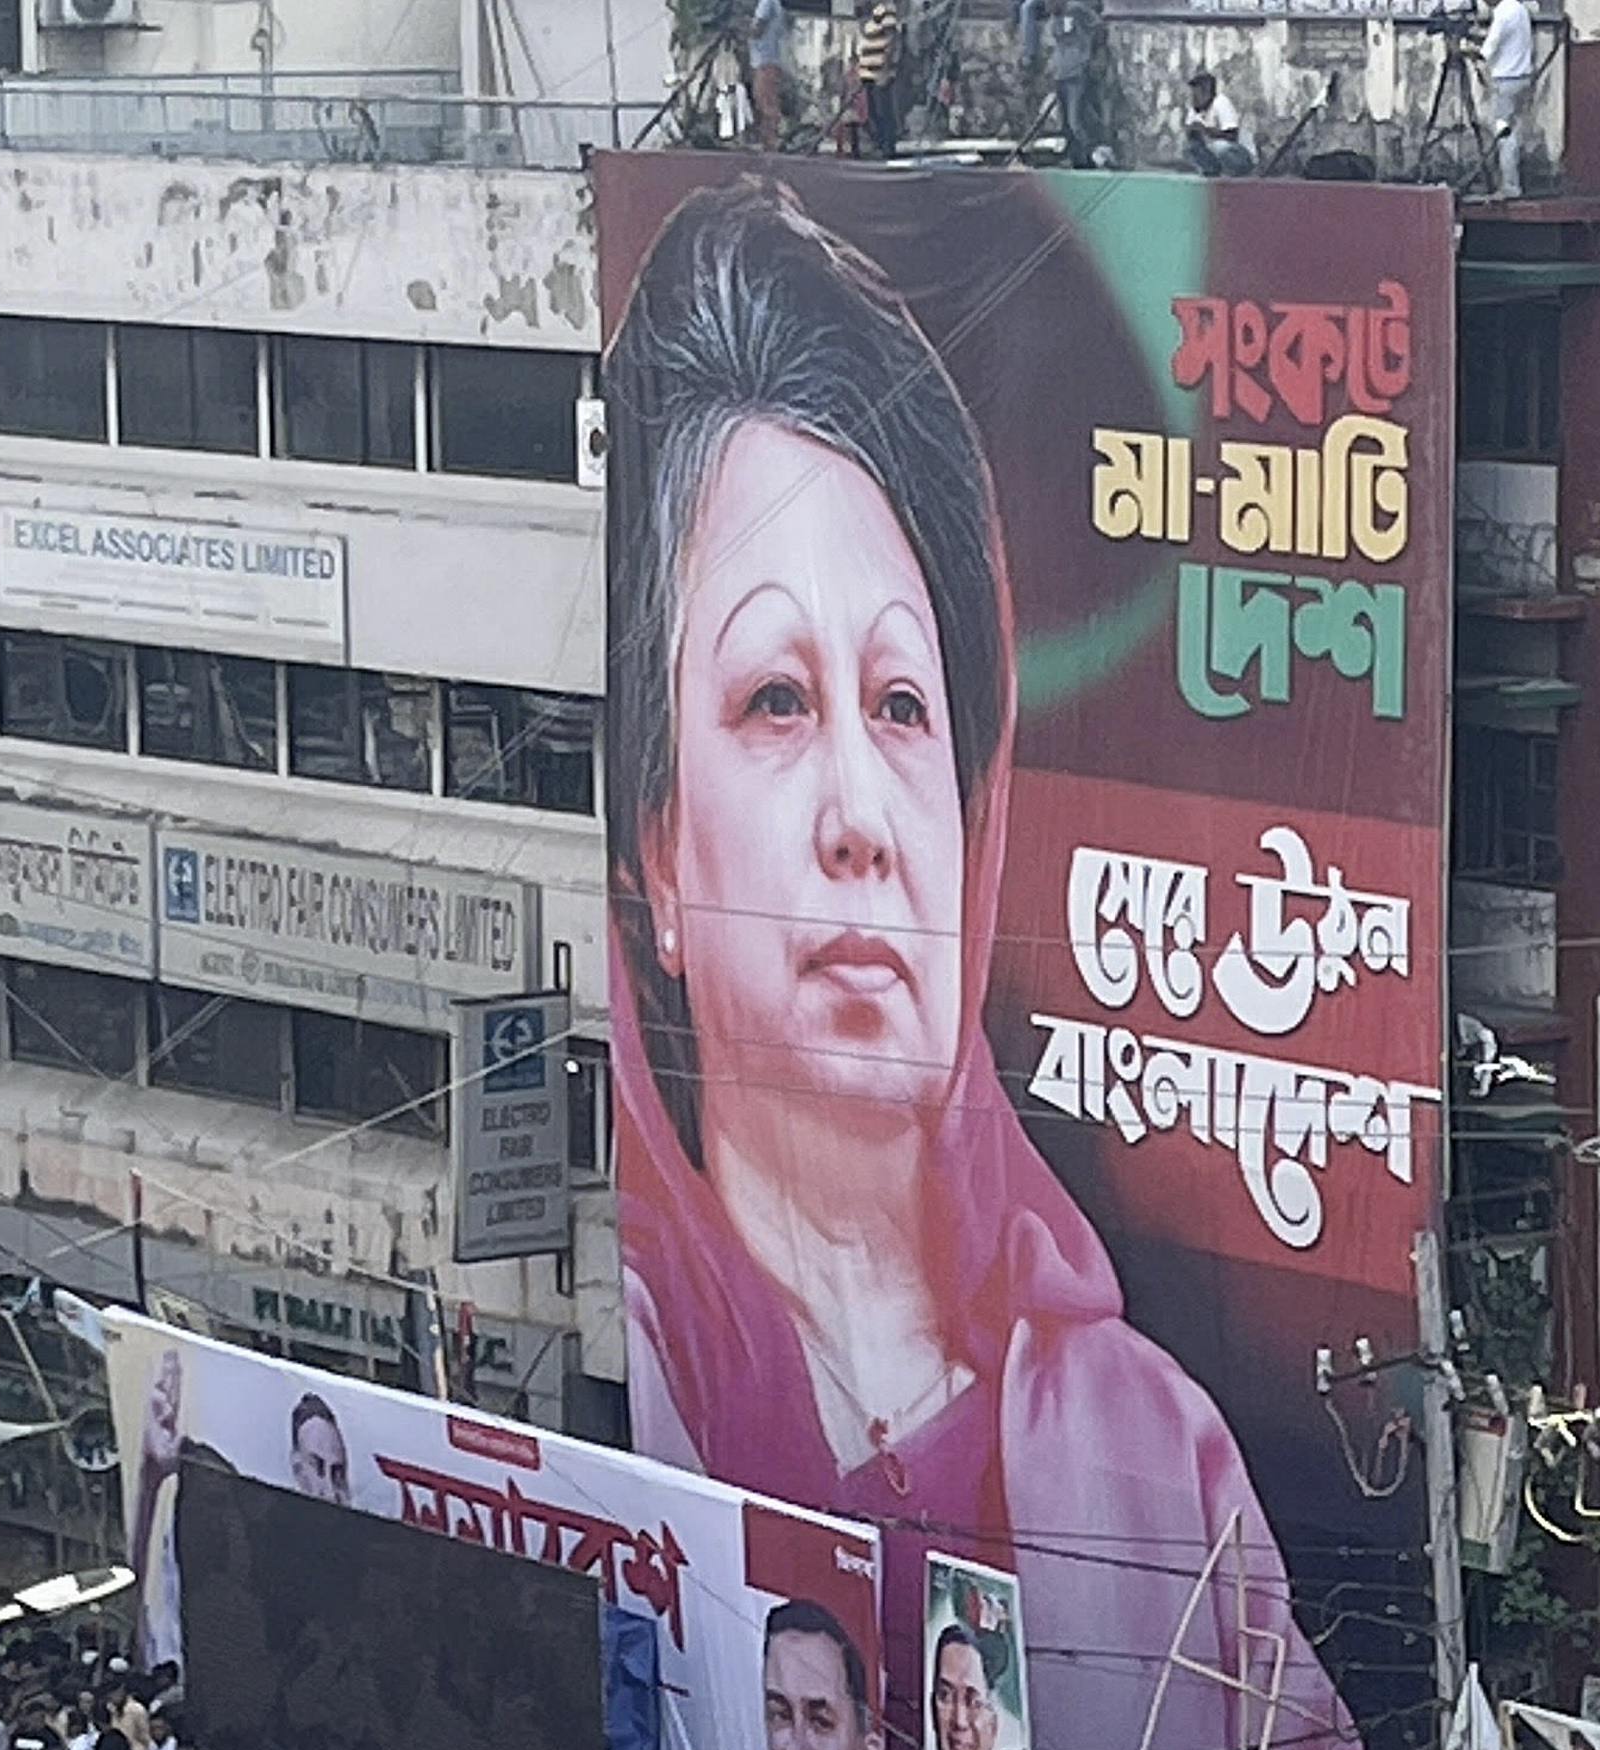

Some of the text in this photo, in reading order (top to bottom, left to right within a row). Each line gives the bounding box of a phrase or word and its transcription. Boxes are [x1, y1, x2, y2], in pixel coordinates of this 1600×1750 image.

[1169, 279, 1414, 425] সংকটে
[13, 518, 336, 580] EXCEL ASSOCIATES LIMITED
[1088, 413, 1412, 565] মা-মাটি
[1175, 561, 1407, 723] দেশ
[205, 854, 282, 935] ELECTRO
[286, 867, 324, 940] FAIR
[329, 873, 441, 961] CONSUMERS
[444, 888, 516, 973] LIMITED
[1066, 823, 1414, 1035] সেরে উঠুন
[1027, 1009, 1442, 1248] বাংলাদেশ
